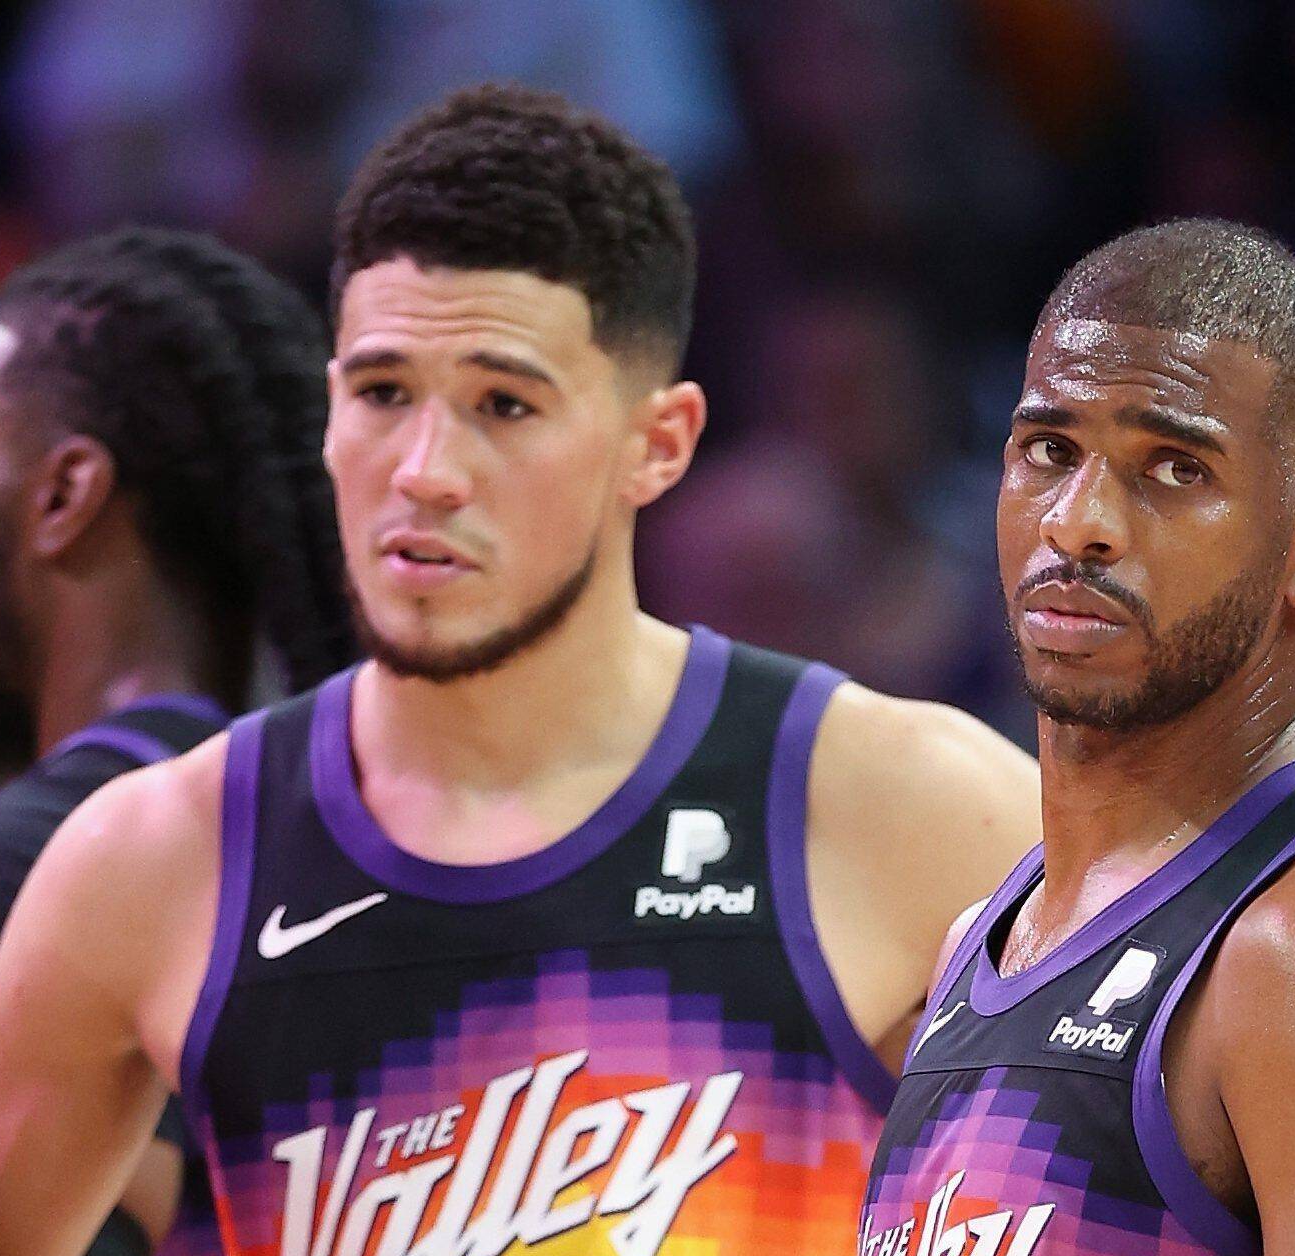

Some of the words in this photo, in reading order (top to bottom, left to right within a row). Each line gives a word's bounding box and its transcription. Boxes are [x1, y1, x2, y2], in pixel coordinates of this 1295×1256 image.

[634, 884, 756, 920] PayPal
[1048, 1016, 1134, 1053] PayPal
[372, 1104, 466, 1170] THE
